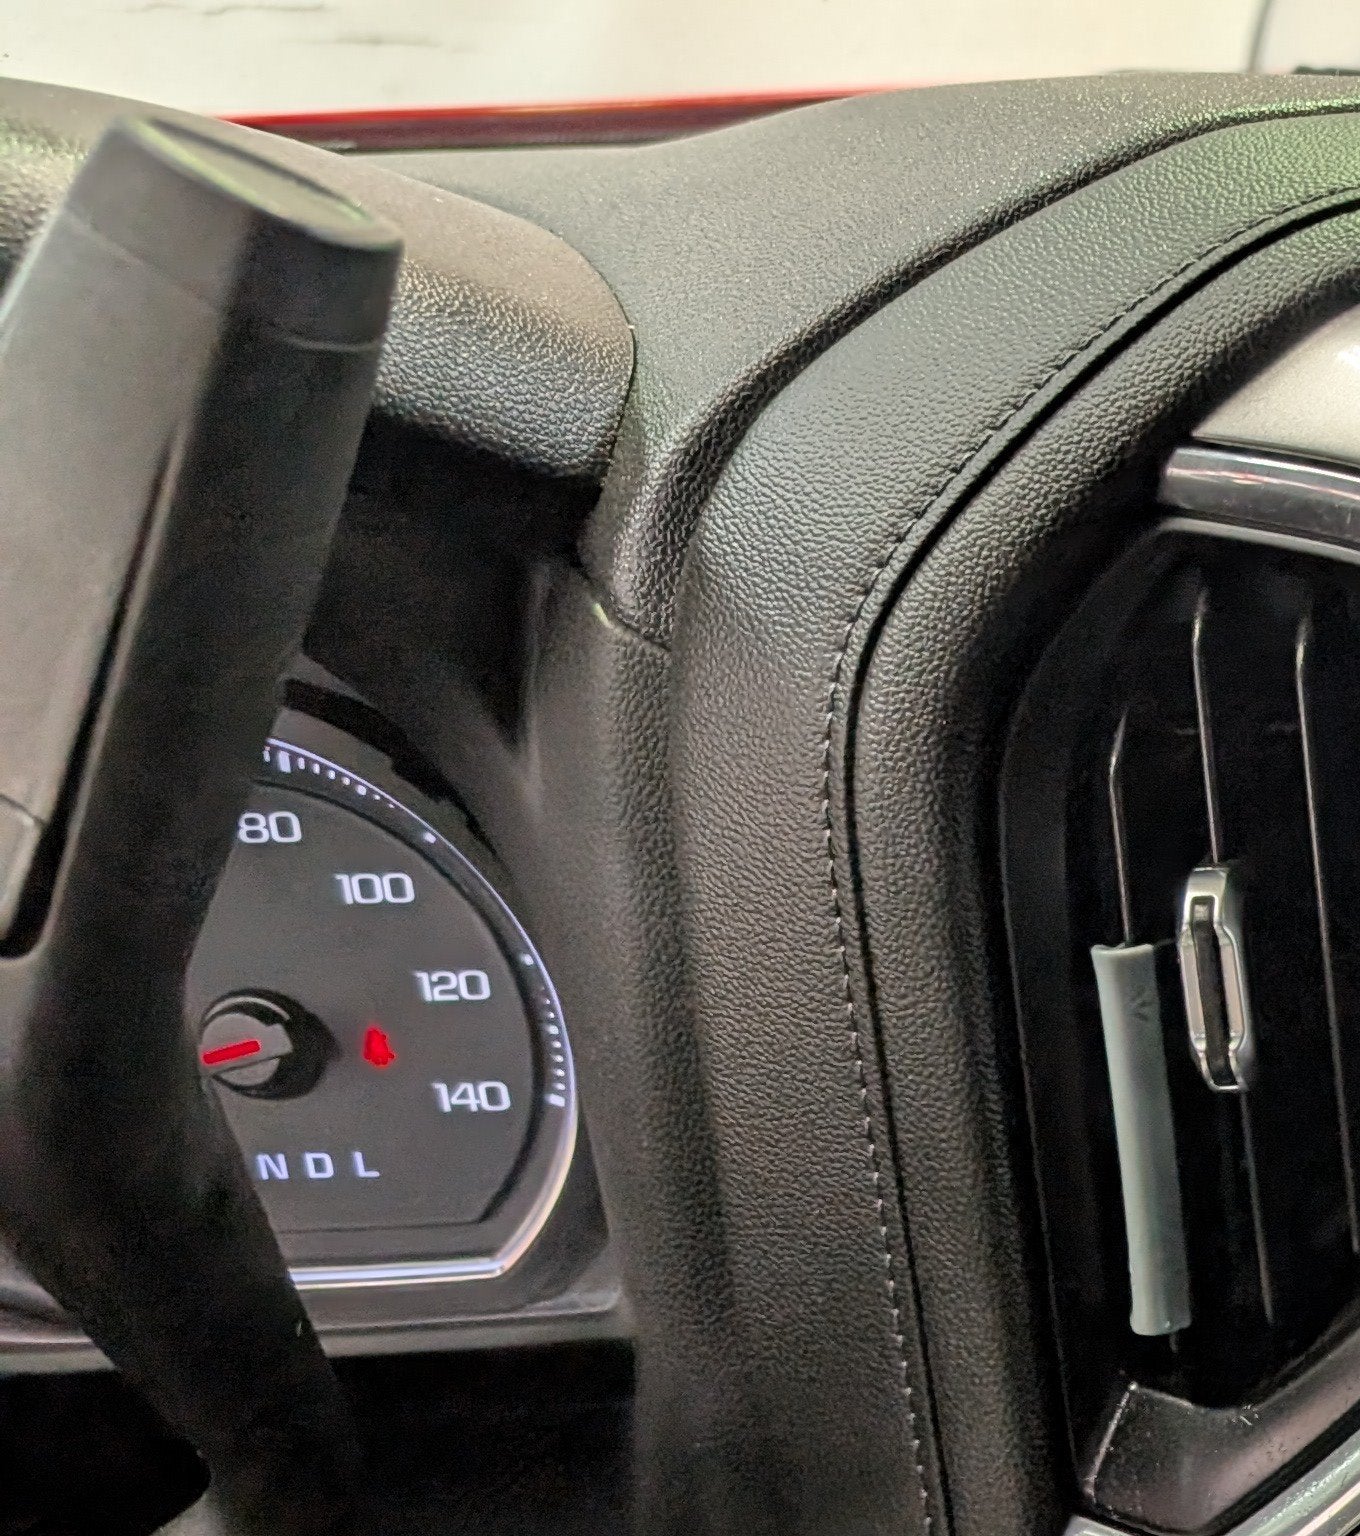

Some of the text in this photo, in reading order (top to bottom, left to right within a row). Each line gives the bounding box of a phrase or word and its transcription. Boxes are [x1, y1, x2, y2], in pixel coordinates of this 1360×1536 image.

[237, 811, 302, 844] 80
[334, 872, 416, 905] 100
[414, 969, 491, 1002] 120
[432, 1081, 511, 1113] 140
[255, 1150, 380, 1181] N D L
